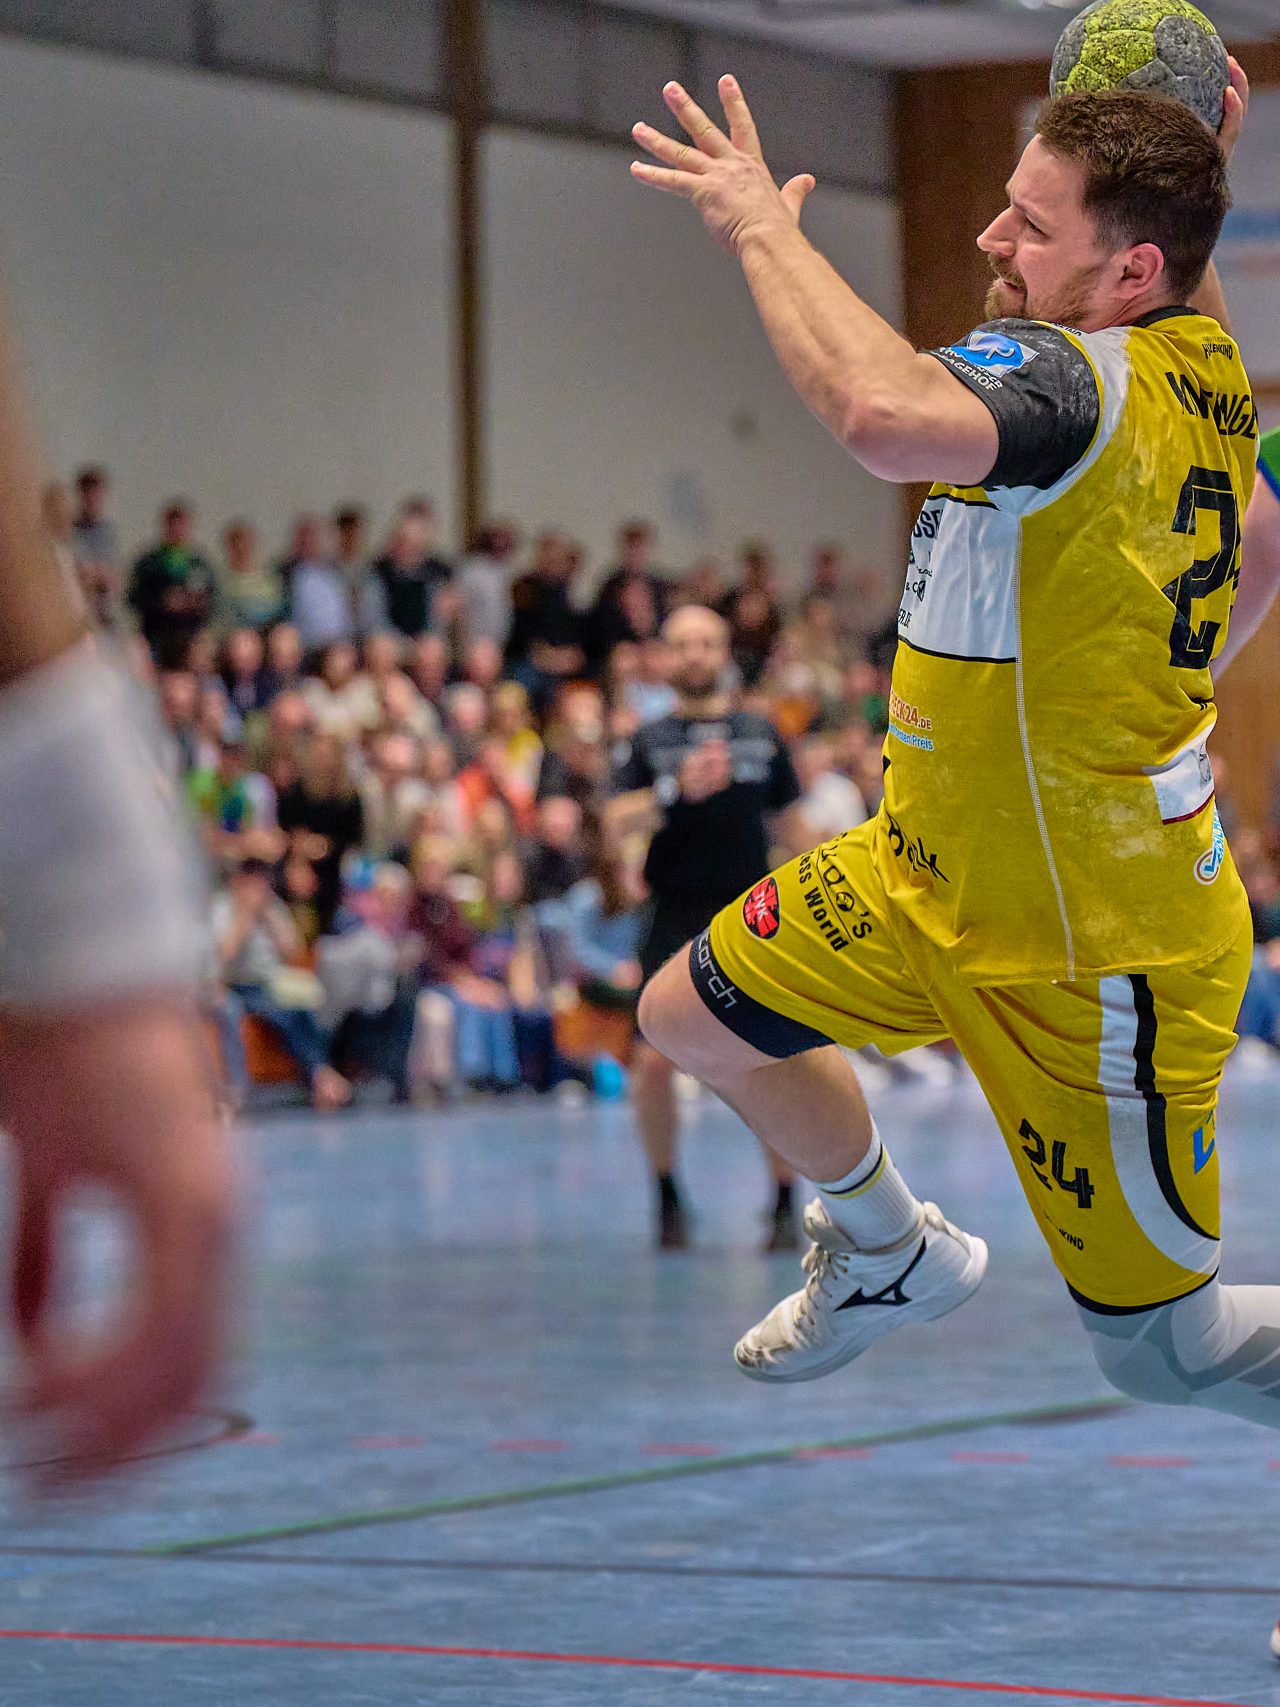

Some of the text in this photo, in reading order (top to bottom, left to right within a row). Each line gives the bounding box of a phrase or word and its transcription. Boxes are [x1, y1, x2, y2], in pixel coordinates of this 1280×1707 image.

[1160, 465, 1241, 670] 2
[912, 734, 934, 750] Preis
[753, 890, 769, 922] TVK
[804, 886, 849, 952] World
[1018, 1118, 1095, 1209] 24
